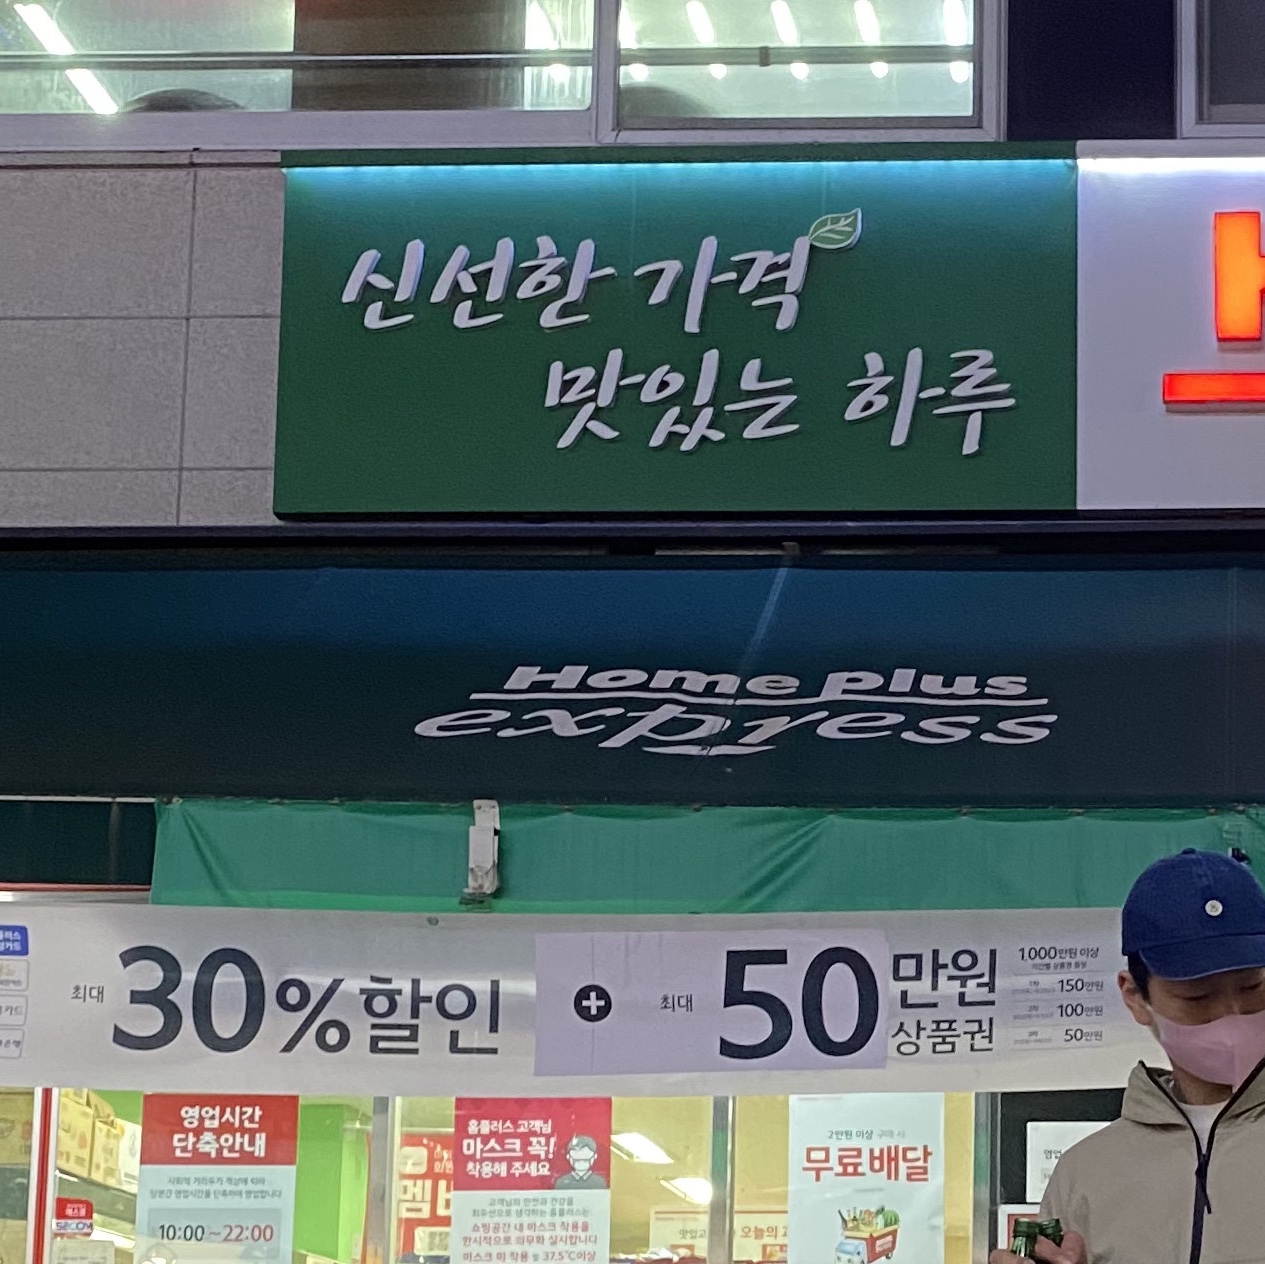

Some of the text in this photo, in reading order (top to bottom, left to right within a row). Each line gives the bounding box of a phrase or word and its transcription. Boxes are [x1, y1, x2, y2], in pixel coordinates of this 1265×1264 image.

[341, 234, 812, 334] 신선한 가격
[544, 347, 1017, 456] 맛있는 하루
[503, 664, 1029, 700] Home plus
[414, 703, 1059, 748] express
[1058, 978, 1104, 993] 150만원
[71, 984, 104, 1003] 최대
[660, 994, 694, 1013] 최대
[1057, 1003, 1104, 1017] 100만원
[891, 1018, 995, 1057] 상품권
[1064, 1028, 1103, 1042] 50만원
[180, 1105, 262, 1129] 영업시간
[468, 1120, 552, 1134] 홈플러스 고객님
[172, 1132, 267, 1158] 단축안내
[828, 1130, 852, 1140] 2만원
[855, 1130, 873, 1140] 이상
[462, 1138, 555, 1159] 마스크 꼭!
[467, 1161, 551, 1177] 착용해 주세요
[802, 1144, 933, 1182] 무료배달
[527, 1222, 557, 1232] 마스크
[463, 1251, 493, 1262] 마스크
